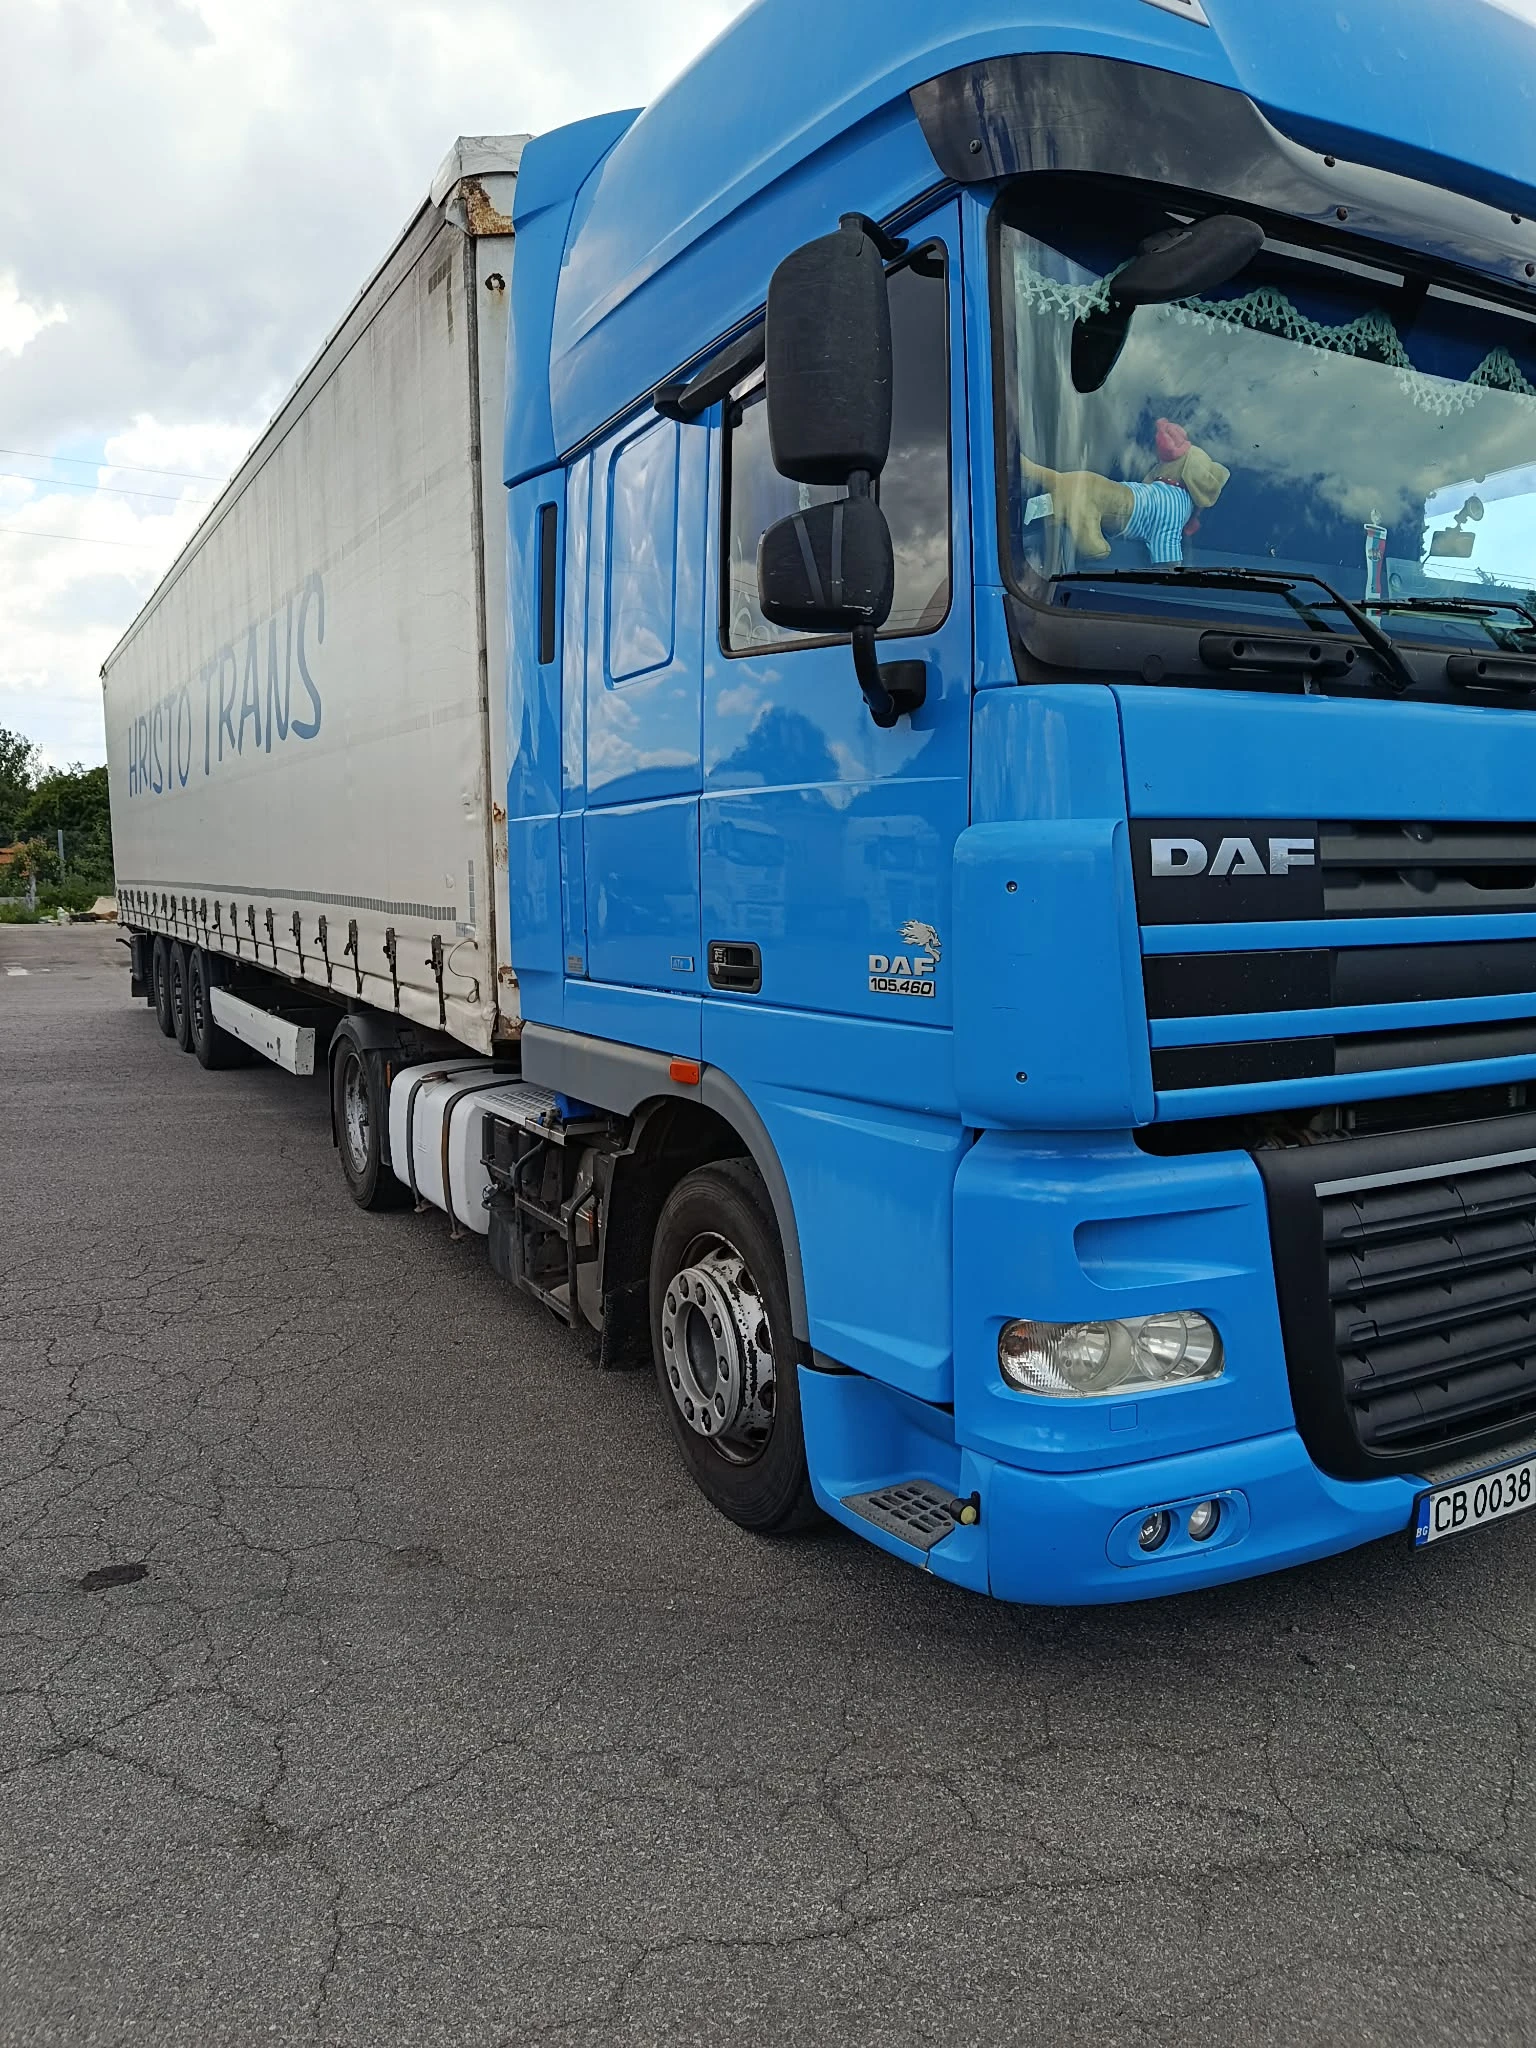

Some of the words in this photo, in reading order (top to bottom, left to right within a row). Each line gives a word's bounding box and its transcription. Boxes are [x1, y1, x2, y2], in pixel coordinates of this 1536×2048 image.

[128, 684, 191, 798] HRISTO
[199, 570, 325, 776] TRANS
[1150, 837, 1315, 876] DAF
[869, 954, 935, 976] DAF
[870, 977, 933, 995] 105.460
[1434, 1490, 1468, 1532] CB
[1473, 1467, 1531, 1518] 0038
[1416, 1525, 1429, 1538] BG
